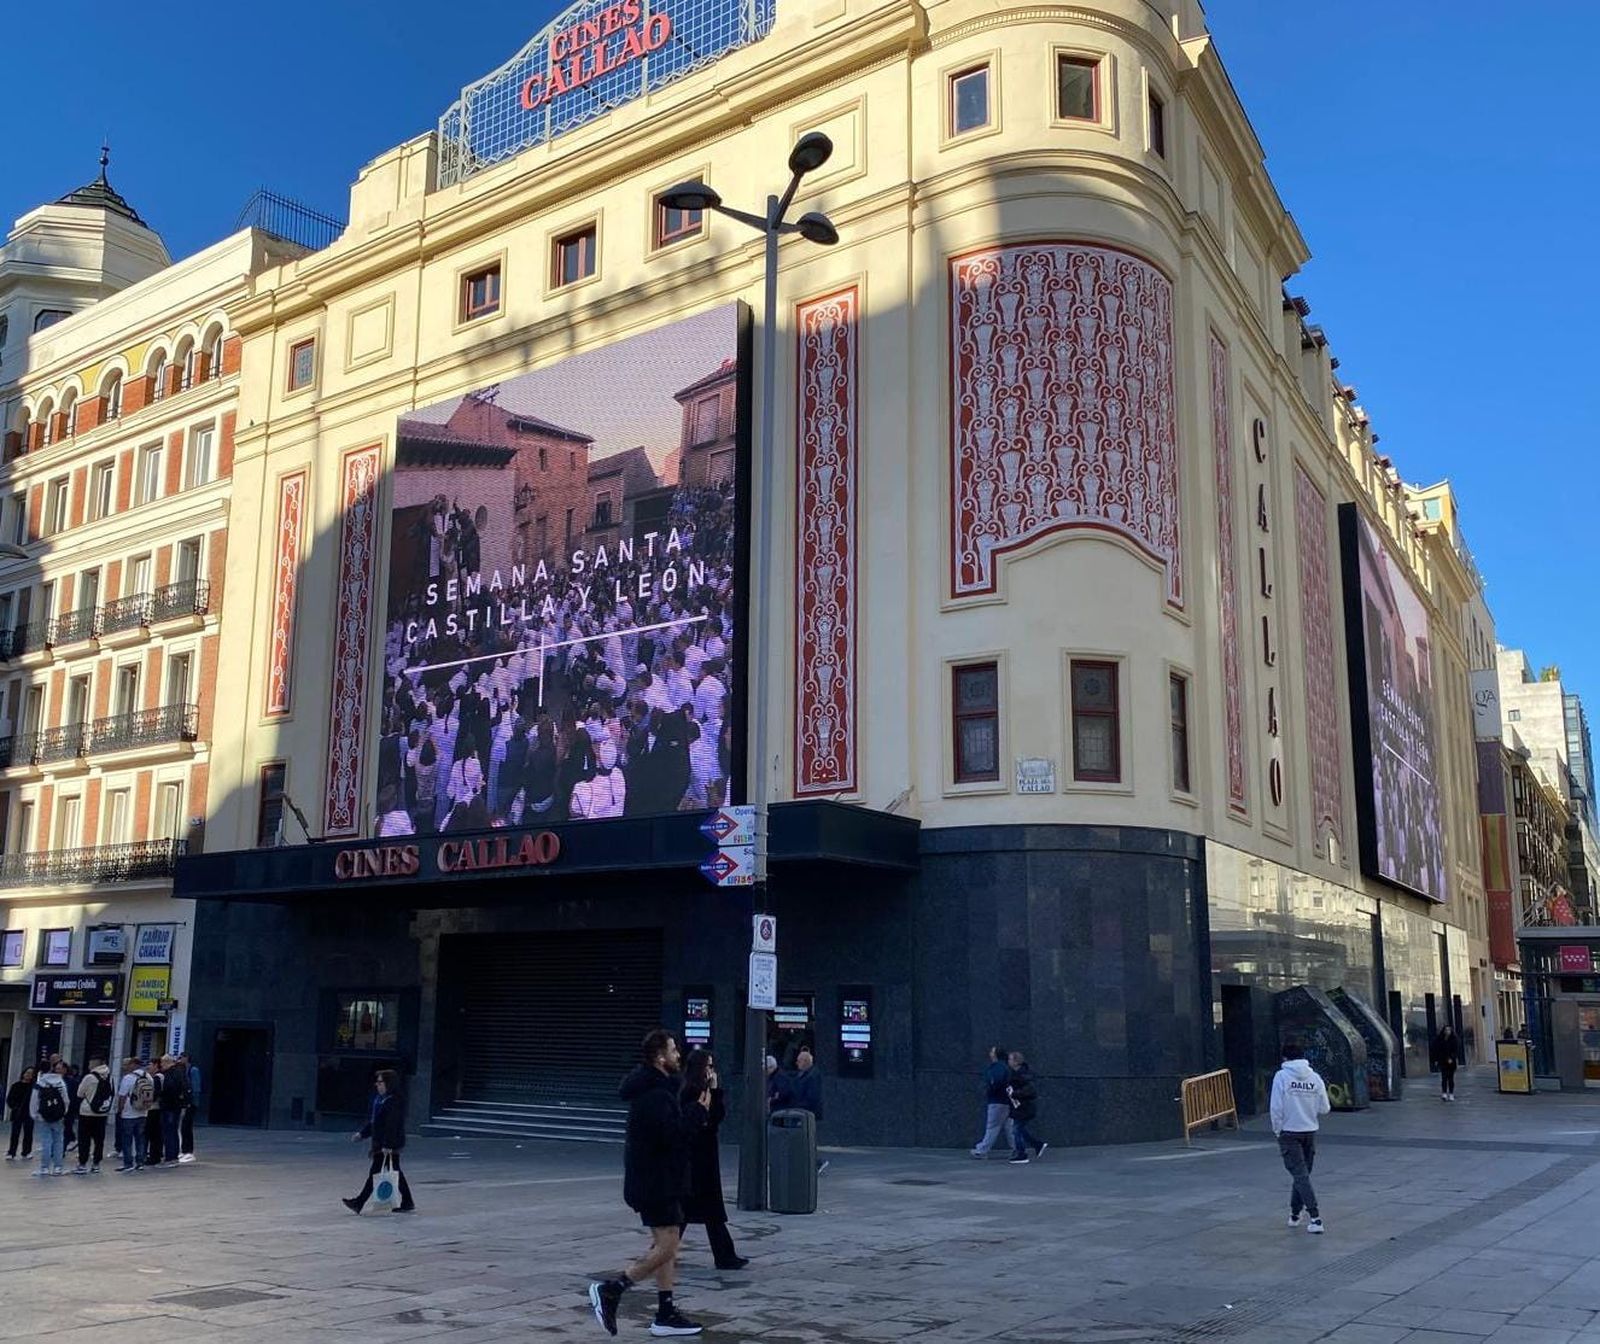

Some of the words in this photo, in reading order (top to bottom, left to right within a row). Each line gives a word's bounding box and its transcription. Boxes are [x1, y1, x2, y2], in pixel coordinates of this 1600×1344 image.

[551, 0, 640, 61] CINES
[520, 13, 671, 110] CALLAO
[426, 560, 548, 605] SEMANA
[571, 527, 682, 573] SANTA
[407, 595, 555, 643] CASTILLA
[578, 586, 591, 609] Y
[615, 560, 706, 602] LEÓN
[1253, 417, 1282, 807] CALLAO
[335, 845, 420, 879] CINES
[437, 831, 560, 872] CALLAO
[139, 945, 167, 958] CHANGE
[142, 930, 170, 943] CAMBIO
[135, 991, 166, 1000] CHANGE
[136, 980, 166, 988] CAMBIO
[173, 1025, 181, 1057] HANGE
[1291, 1081, 1315, 1090] DAILY
